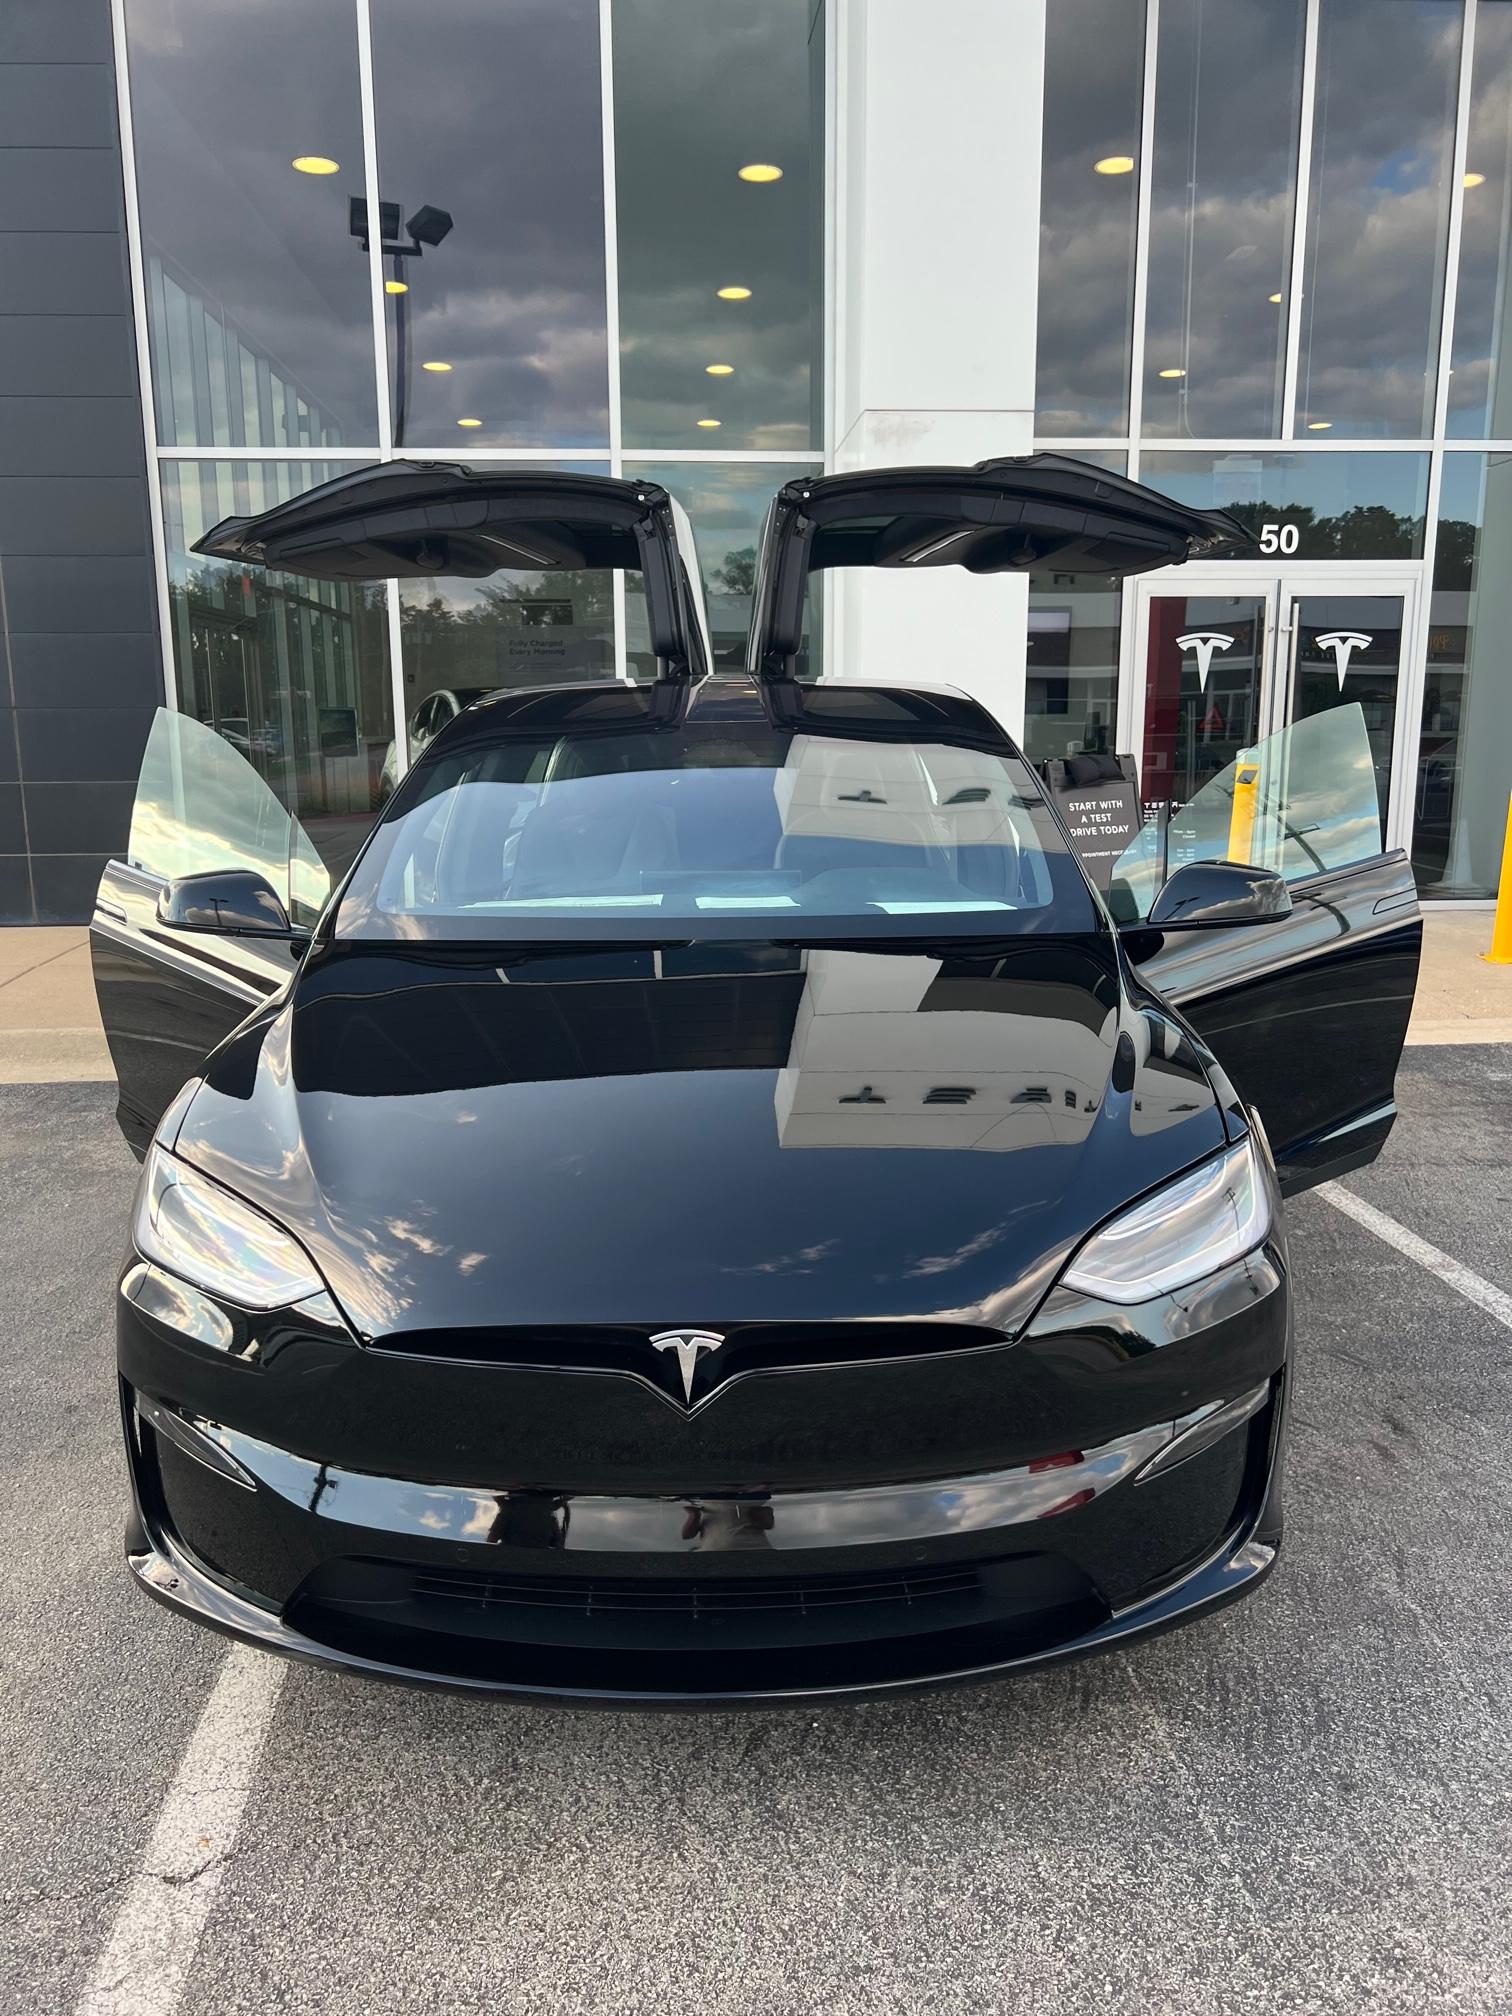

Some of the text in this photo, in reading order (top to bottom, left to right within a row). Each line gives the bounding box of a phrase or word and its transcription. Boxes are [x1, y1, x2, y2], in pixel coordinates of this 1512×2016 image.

[1259, 524, 1299, 554] 50
[1068, 800, 1123, 811] START WITH
[1081, 813, 1112, 823] A TEST
[1070, 825, 1129, 837] DRIVE TODAY
